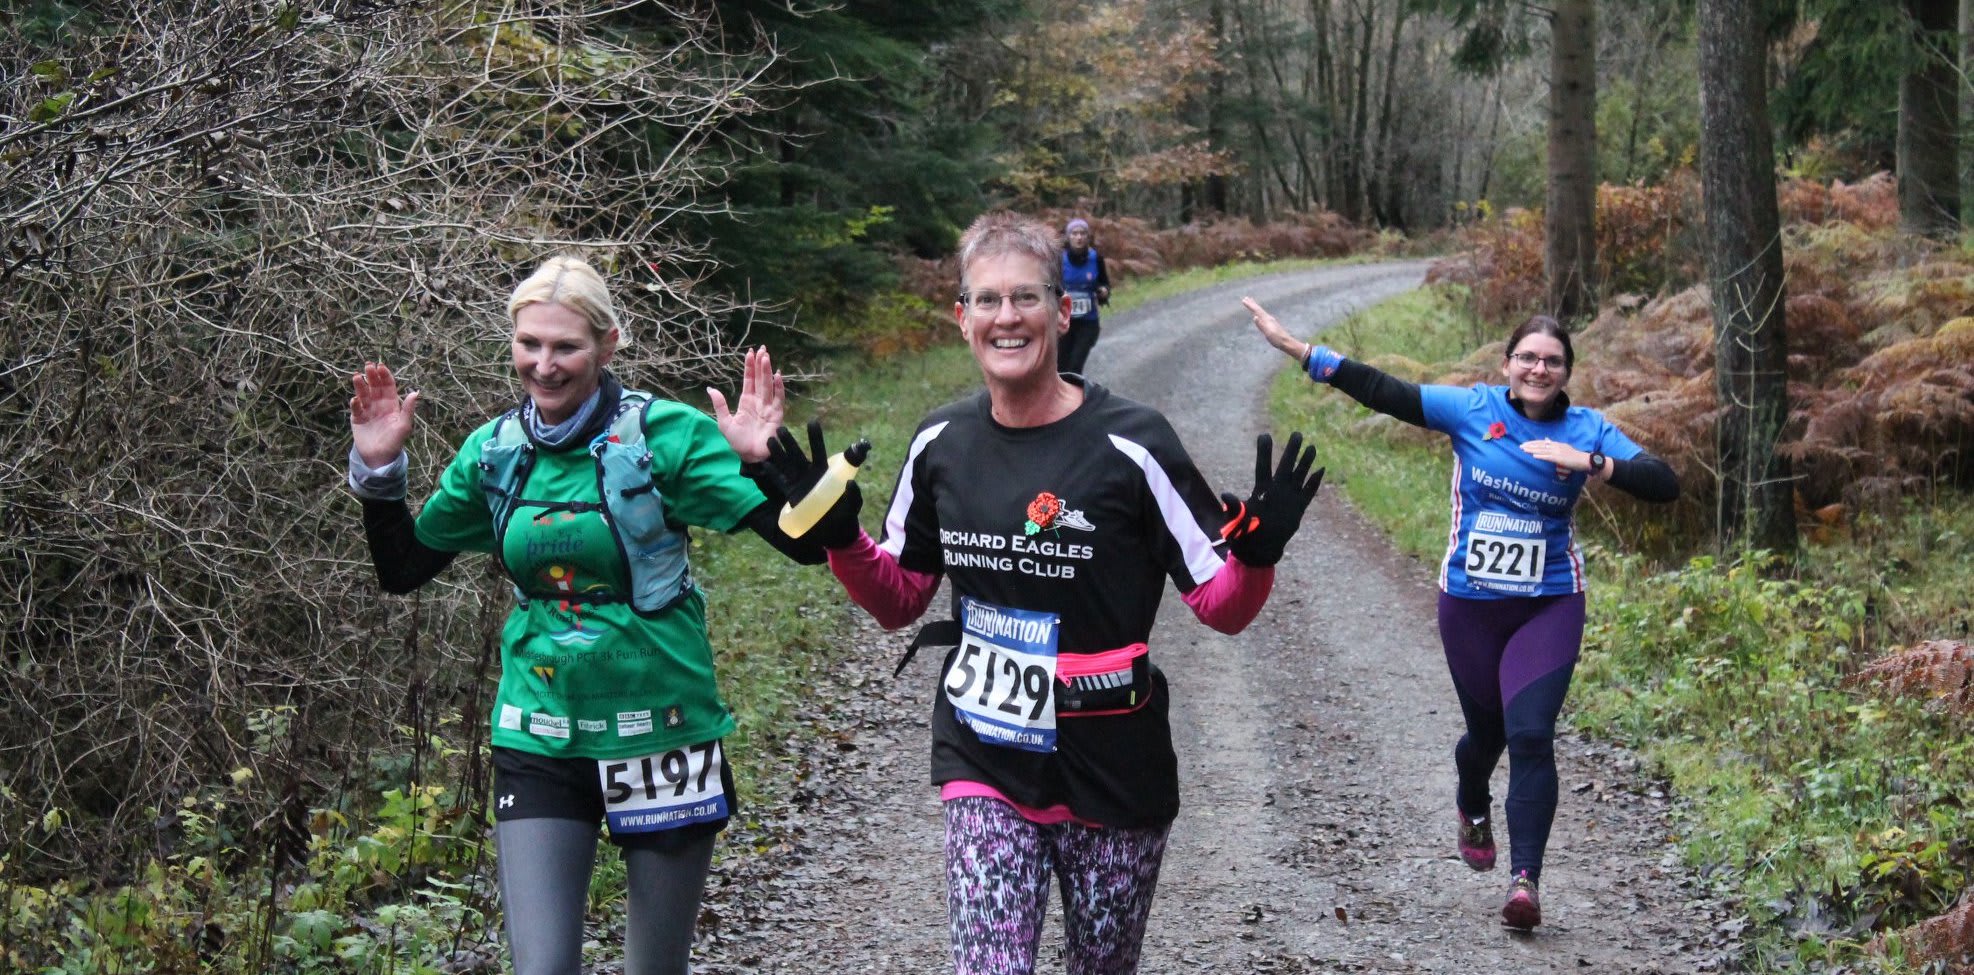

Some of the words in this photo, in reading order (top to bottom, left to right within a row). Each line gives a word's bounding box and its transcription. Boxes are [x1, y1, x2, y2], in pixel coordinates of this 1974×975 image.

[1471, 465, 1567, 507] Washington
[1479, 512, 1504, 532] RUN
[1503, 518, 1543, 534] NATION
[526, 535, 584, 561] pride
[940, 528, 1006, 550] ORCHARD
[1011, 535, 1094, 559] EAGLES
[1467, 539, 1540, 577] 5221
[944, 549, 1013, 571] RUNNING
[1018, 558, 1076, 579] CLUB
[969, 604, 996, 637] RUN
[994, 613, 1052, 645] NATION
[616, 648, 637, 660] Fun
[947, 644, 1050, 721] 5129
[606, 742, 717, 805] 5197
[620, 803, 718, 828] WWW.RUNNATION.CO.UK
